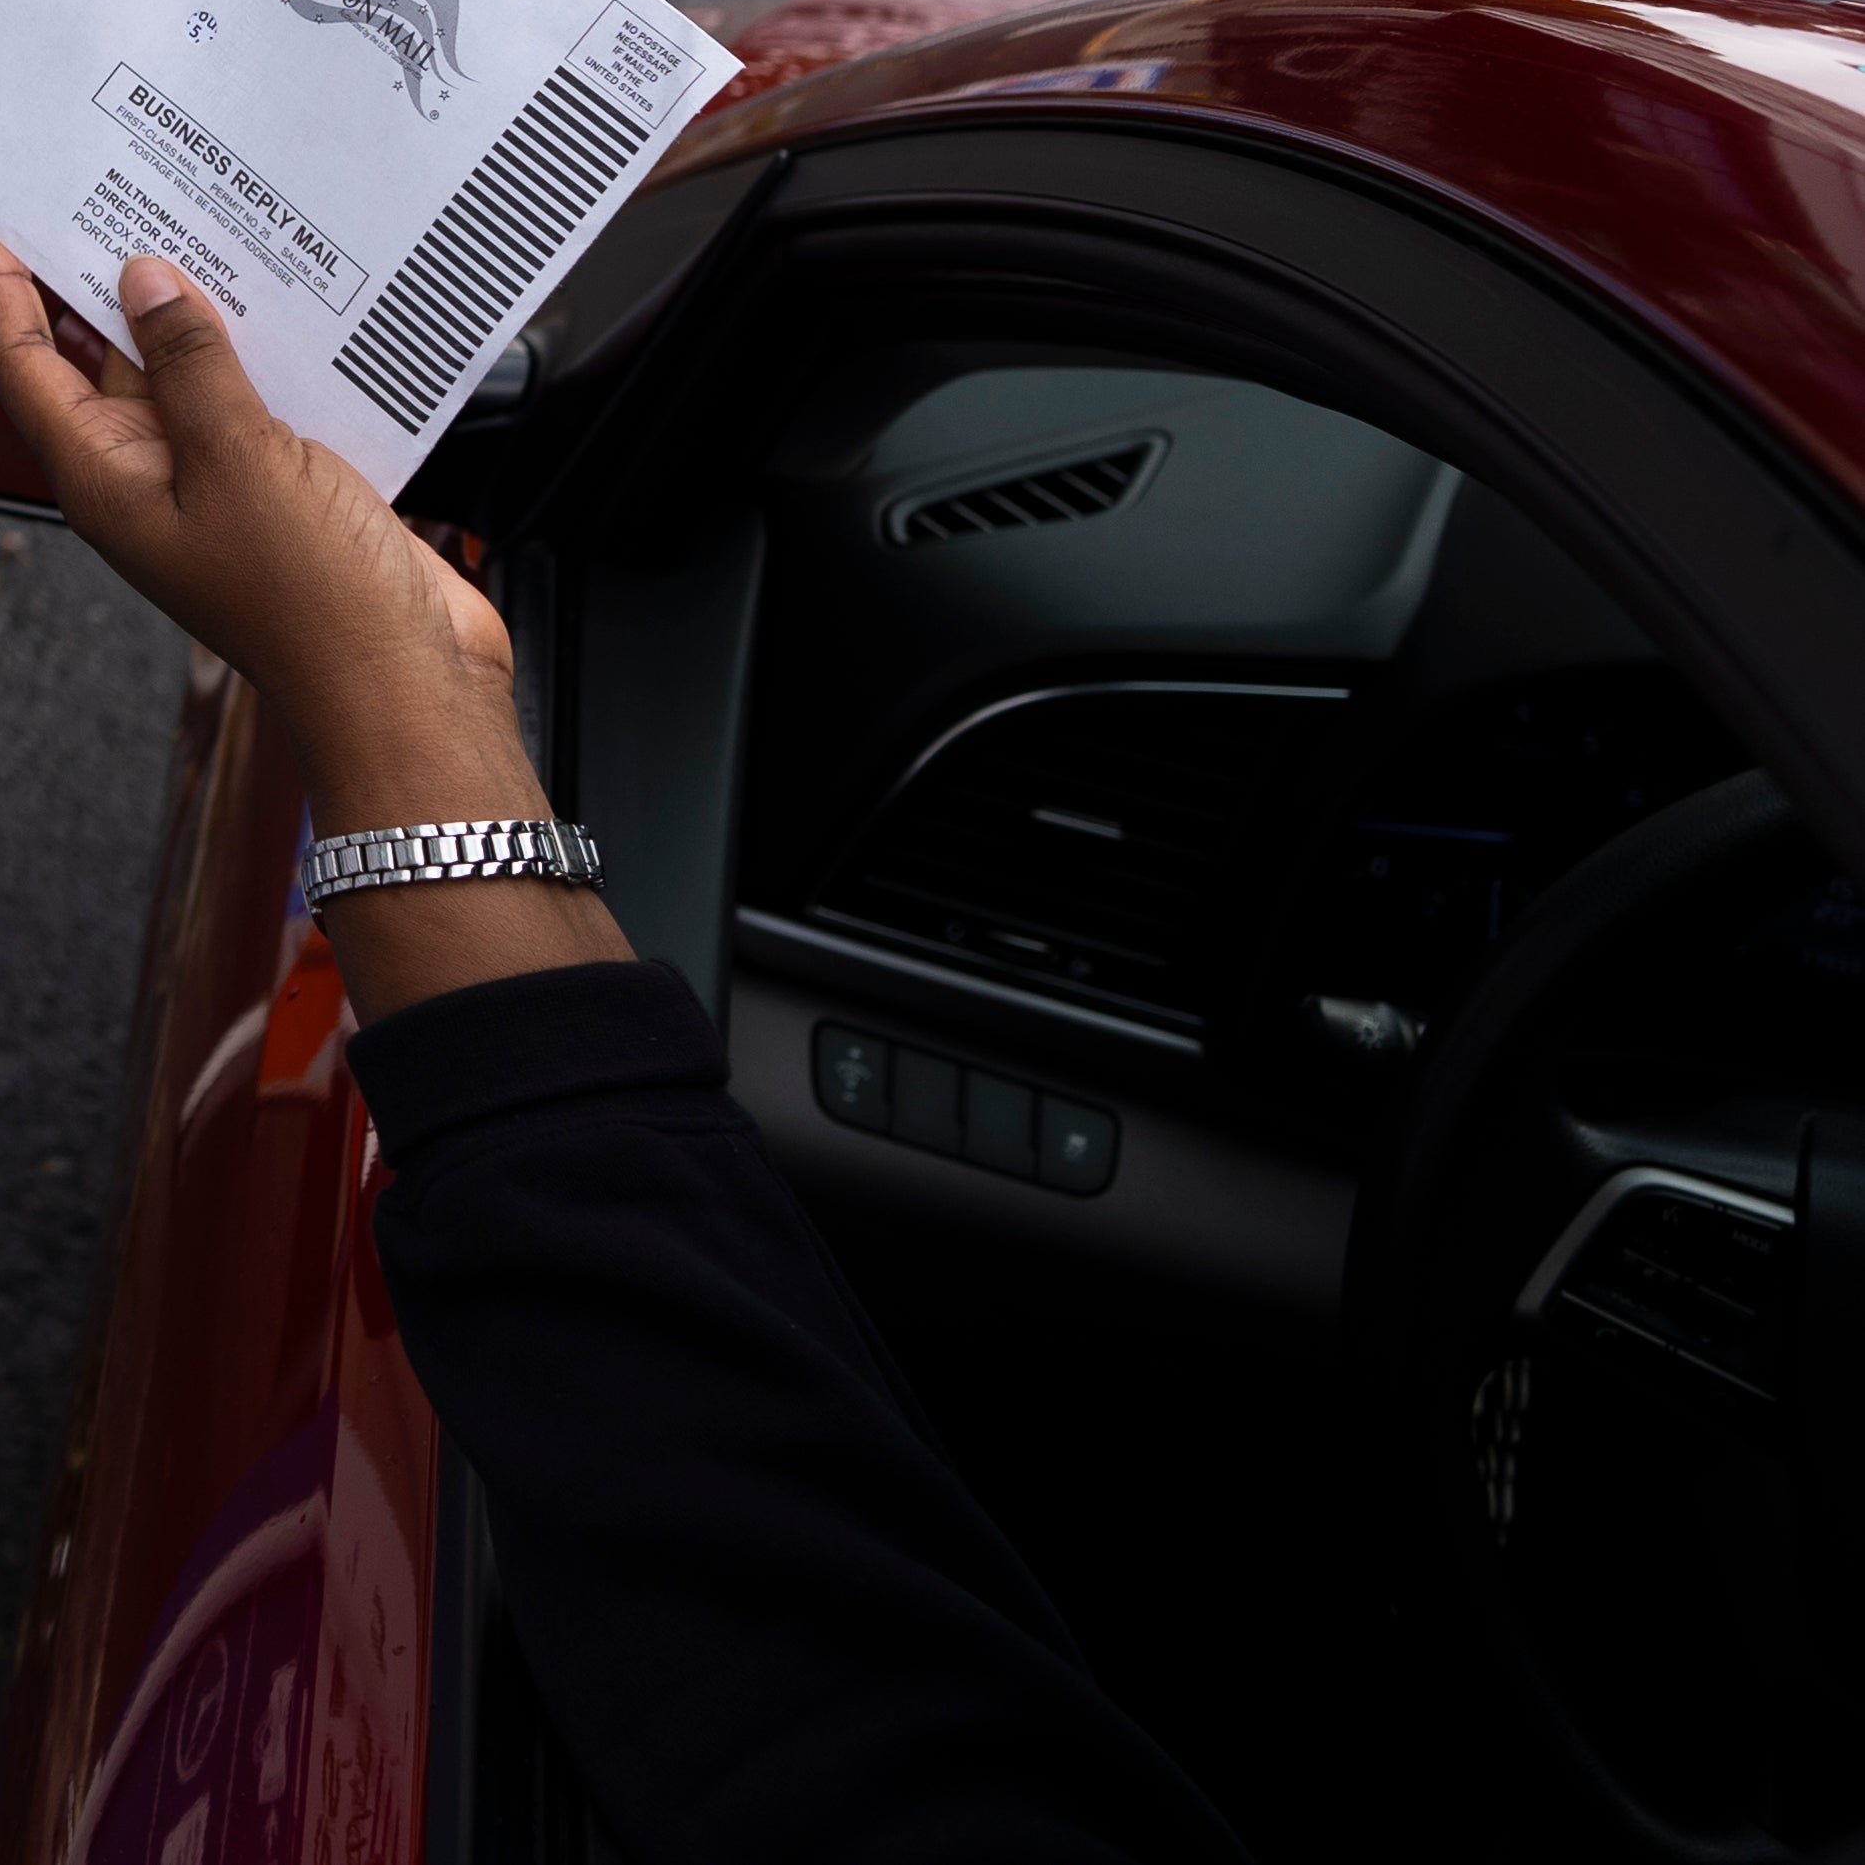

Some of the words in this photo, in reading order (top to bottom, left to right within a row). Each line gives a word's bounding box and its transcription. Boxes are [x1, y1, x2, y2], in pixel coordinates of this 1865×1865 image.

[377, 14, 436, 72] MAIL
[612, 45, 624, 55] IF
[623, 53, 658, 83] MAILED
[616, 31, 672, 76] NECESSARY
[622, 20, 639, 35] NO
[637, 32, 682, 68] POSTAGE
[584, 56, 619, 85] UNITED
[618, 83, 654, 112] STATES
[611, 61, 624, 73] IN
[625, 69, 644, 88] THE
[116, 105, 178, 157] FIRST-CLASS
[176, 154, 198, 178] MAIL
[209, 183, 244, 216] PERMIT
[242, 211, 261, 229] NO.
[259, 225, 272, 240] 25
[281, 247, 312, 278] SALEM,
[312, 276, 329, 293] OR
[128, 85, 232, 176] BUSINESS
[230, 169, 296, 230] REPLY
[292, 224, 339, 278] MAIL
[71, 211, 129, 261] PORTLAN
[82, 197, 104, 218] PO
[103, 213, 134, 243] BOX
[105, 168, 188, 240] MULTNOMAH
[187, 235, 239, 283] COUNTY
[128, 140, 174, 181] POSTAGE
[173, 176, 196, 200] WILL
[195, 193, 208, 211] BE
[208, 206, 231, 230] PAID
[228, 223, 245, 240] BY
[241, 237, 296, 289] ADDRESSEE
[94, 182, 162, 242] DIRECTOR
[160, 237, 182, 256] OF
[179, 253, 248, 318] ELECTIONS
